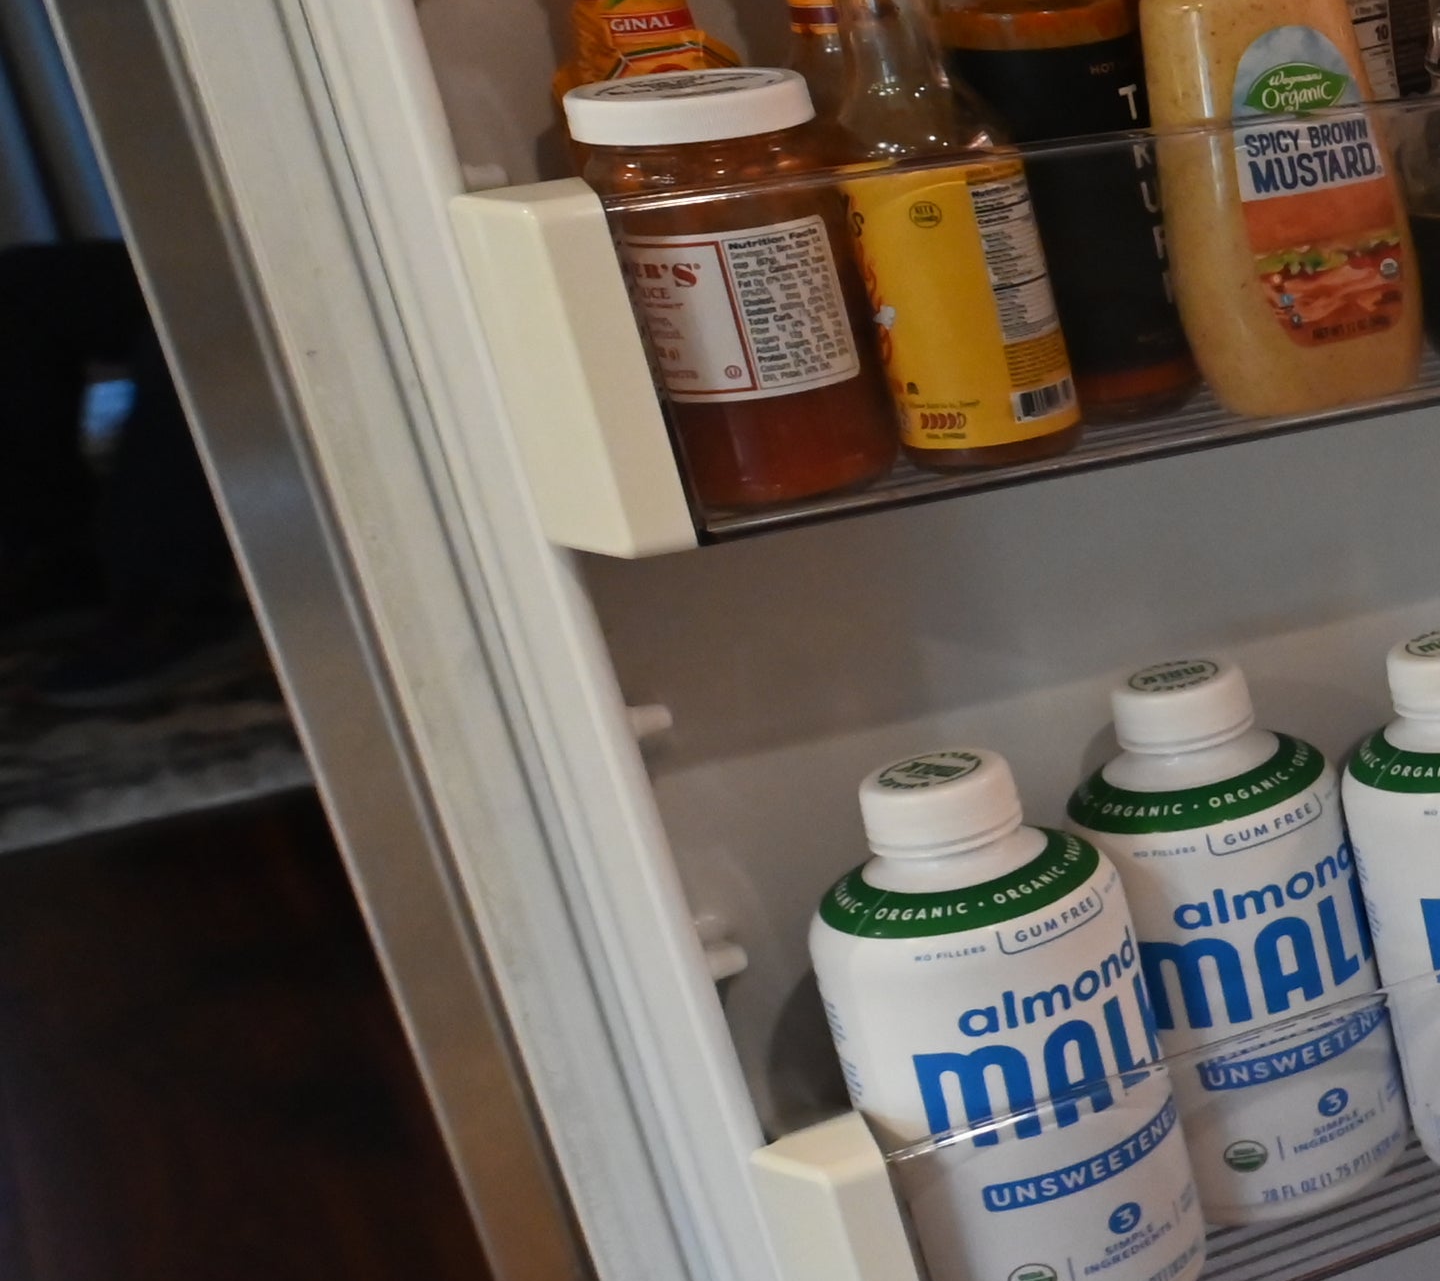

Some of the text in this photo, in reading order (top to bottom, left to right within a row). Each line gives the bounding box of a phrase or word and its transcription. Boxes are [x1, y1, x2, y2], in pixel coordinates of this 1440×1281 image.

[611, 15, 674, 32] GINAL
[1375, 24, 1388, 41] 10
[1262, 81, 1333, 111] Organic
[1244, 119, 1368, 158] SPICY BROWN
[1248, 142, 1377, 194] MUSTARD
[728, 227, 817, 250] Nutrition Facts
[758, 353, 787, 363] Protein
[1101, 770, 1290, 817] ORGANIC ORGANIC
[1222, 802, 1312, 846] GUM FREE
[1152, 846, 1197, 858] FILLERS
[874, 865, 1066, 922] ORGANIC ORGANIC
[1014, 896, 1095, 943] GUM FREE
[936, 945, 987, 960] FILLERS
[958, 925, 1135, 1038] almond
[1325, 1094, 1342, 1112] 3
[1293, 1108, 1377, 1154] INGREDIENTS
[1313, 1108, 1359, 1136] SIMPLE
[990, 1107, 1177, 1208] UNSWEETENE
[1282, 1178, 1318, 1199] FL OZ
[1115, 1206, 1135, 1230] 3
[1084, 1222, 1172, 1277] INGREDIENTS
[1104, 1223, 1155, 1256] SIMPLE
